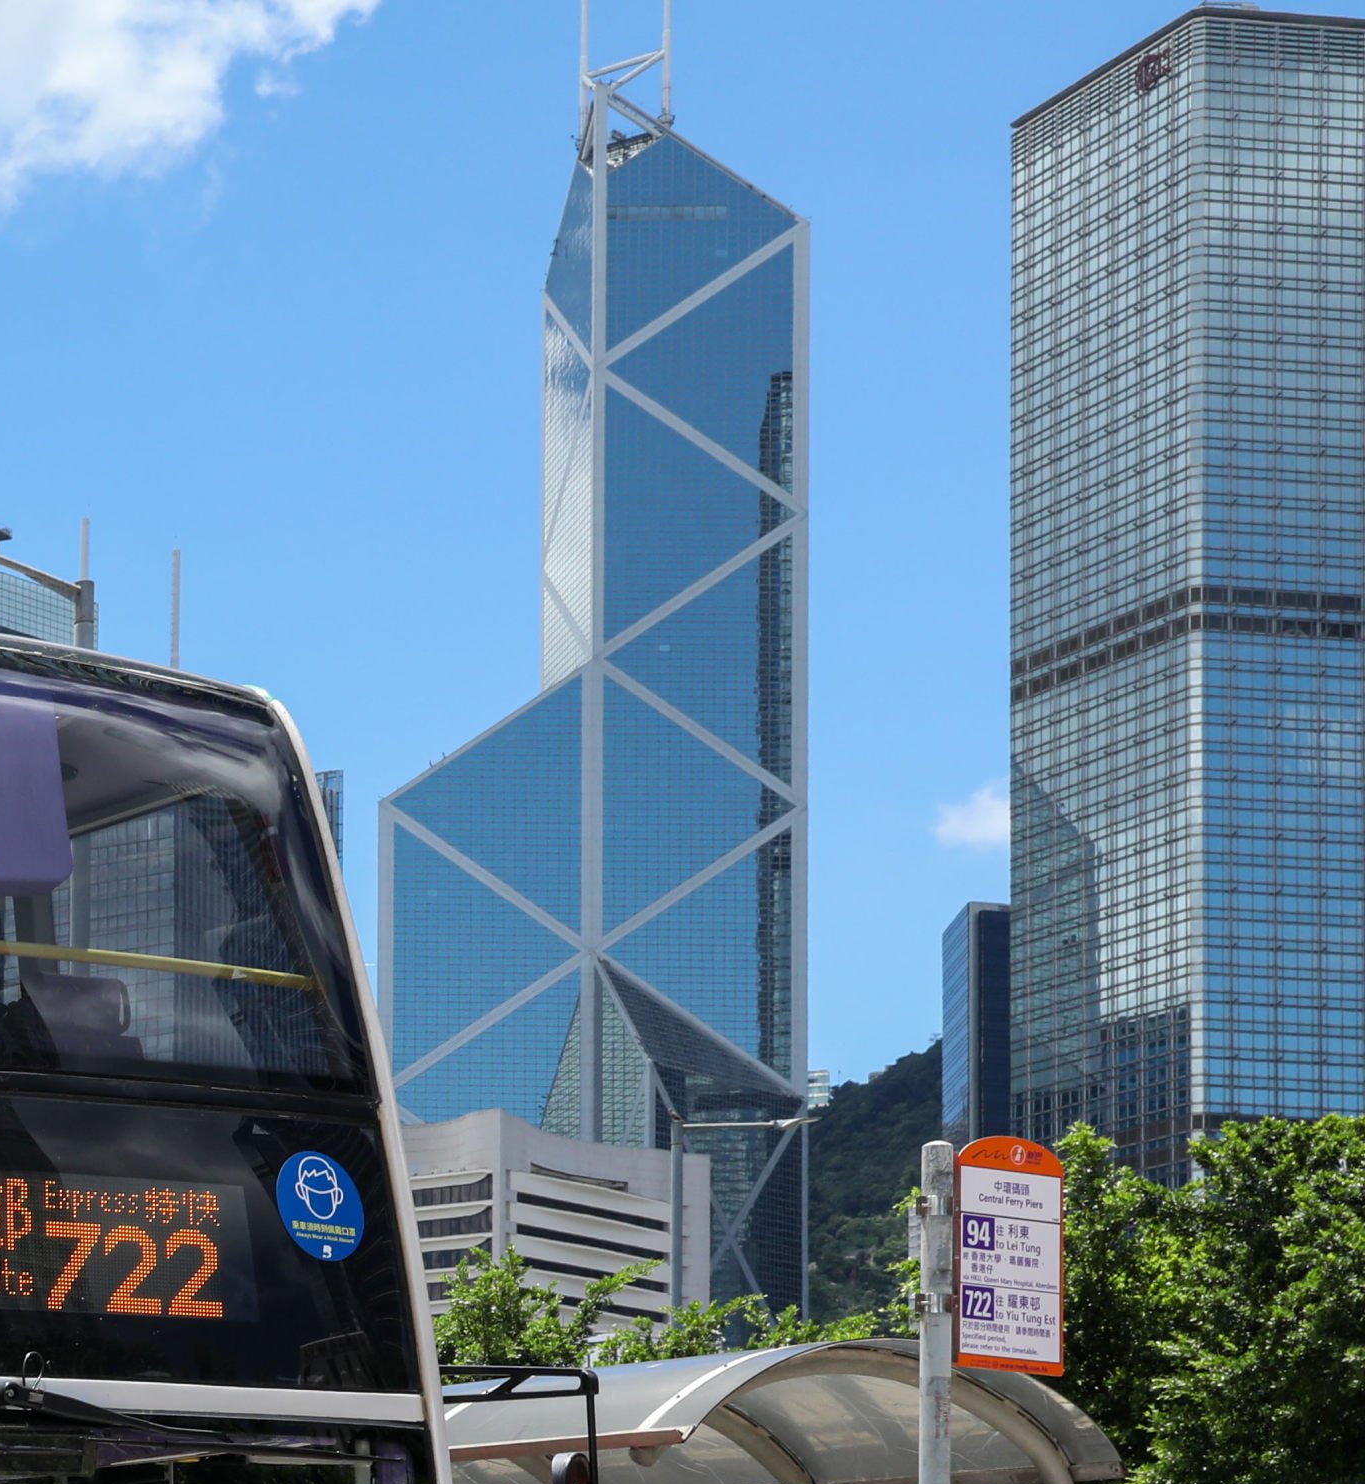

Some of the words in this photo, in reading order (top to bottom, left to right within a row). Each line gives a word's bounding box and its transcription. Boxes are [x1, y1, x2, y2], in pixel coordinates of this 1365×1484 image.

[994, 1181, 1030, 1196] 中環碼頭
[44, 1180, 139, 1218] Express
[979, 1193, 1004, 1204] Central
[1005, 1197, 1023, 1208] Ferry
[1026, 1199, 1043, 1209] Piers
[967, 1220, 990, 1247] 94
[996, 1225, 1004, 1237] 往
[1008, 1224, 1029, 1240] 利東
[996, 1241, 1005, 1250] to
[1007, 1241, 1018, 1251] Lei
[1021, 1242, 1041, 1256] Tung
[45, 1220, 223, 1318] 722
[965, 1290, 992, 1318] 722
[996, 1295, 1004, 1307] 往
[996, 1310, 1004, 1319] to
[1006, 1311, 1019, 1321] Yiu
[1021, 1312, 1042, 1327] Tung
[1044, 1315, 1056, 1325] Est
